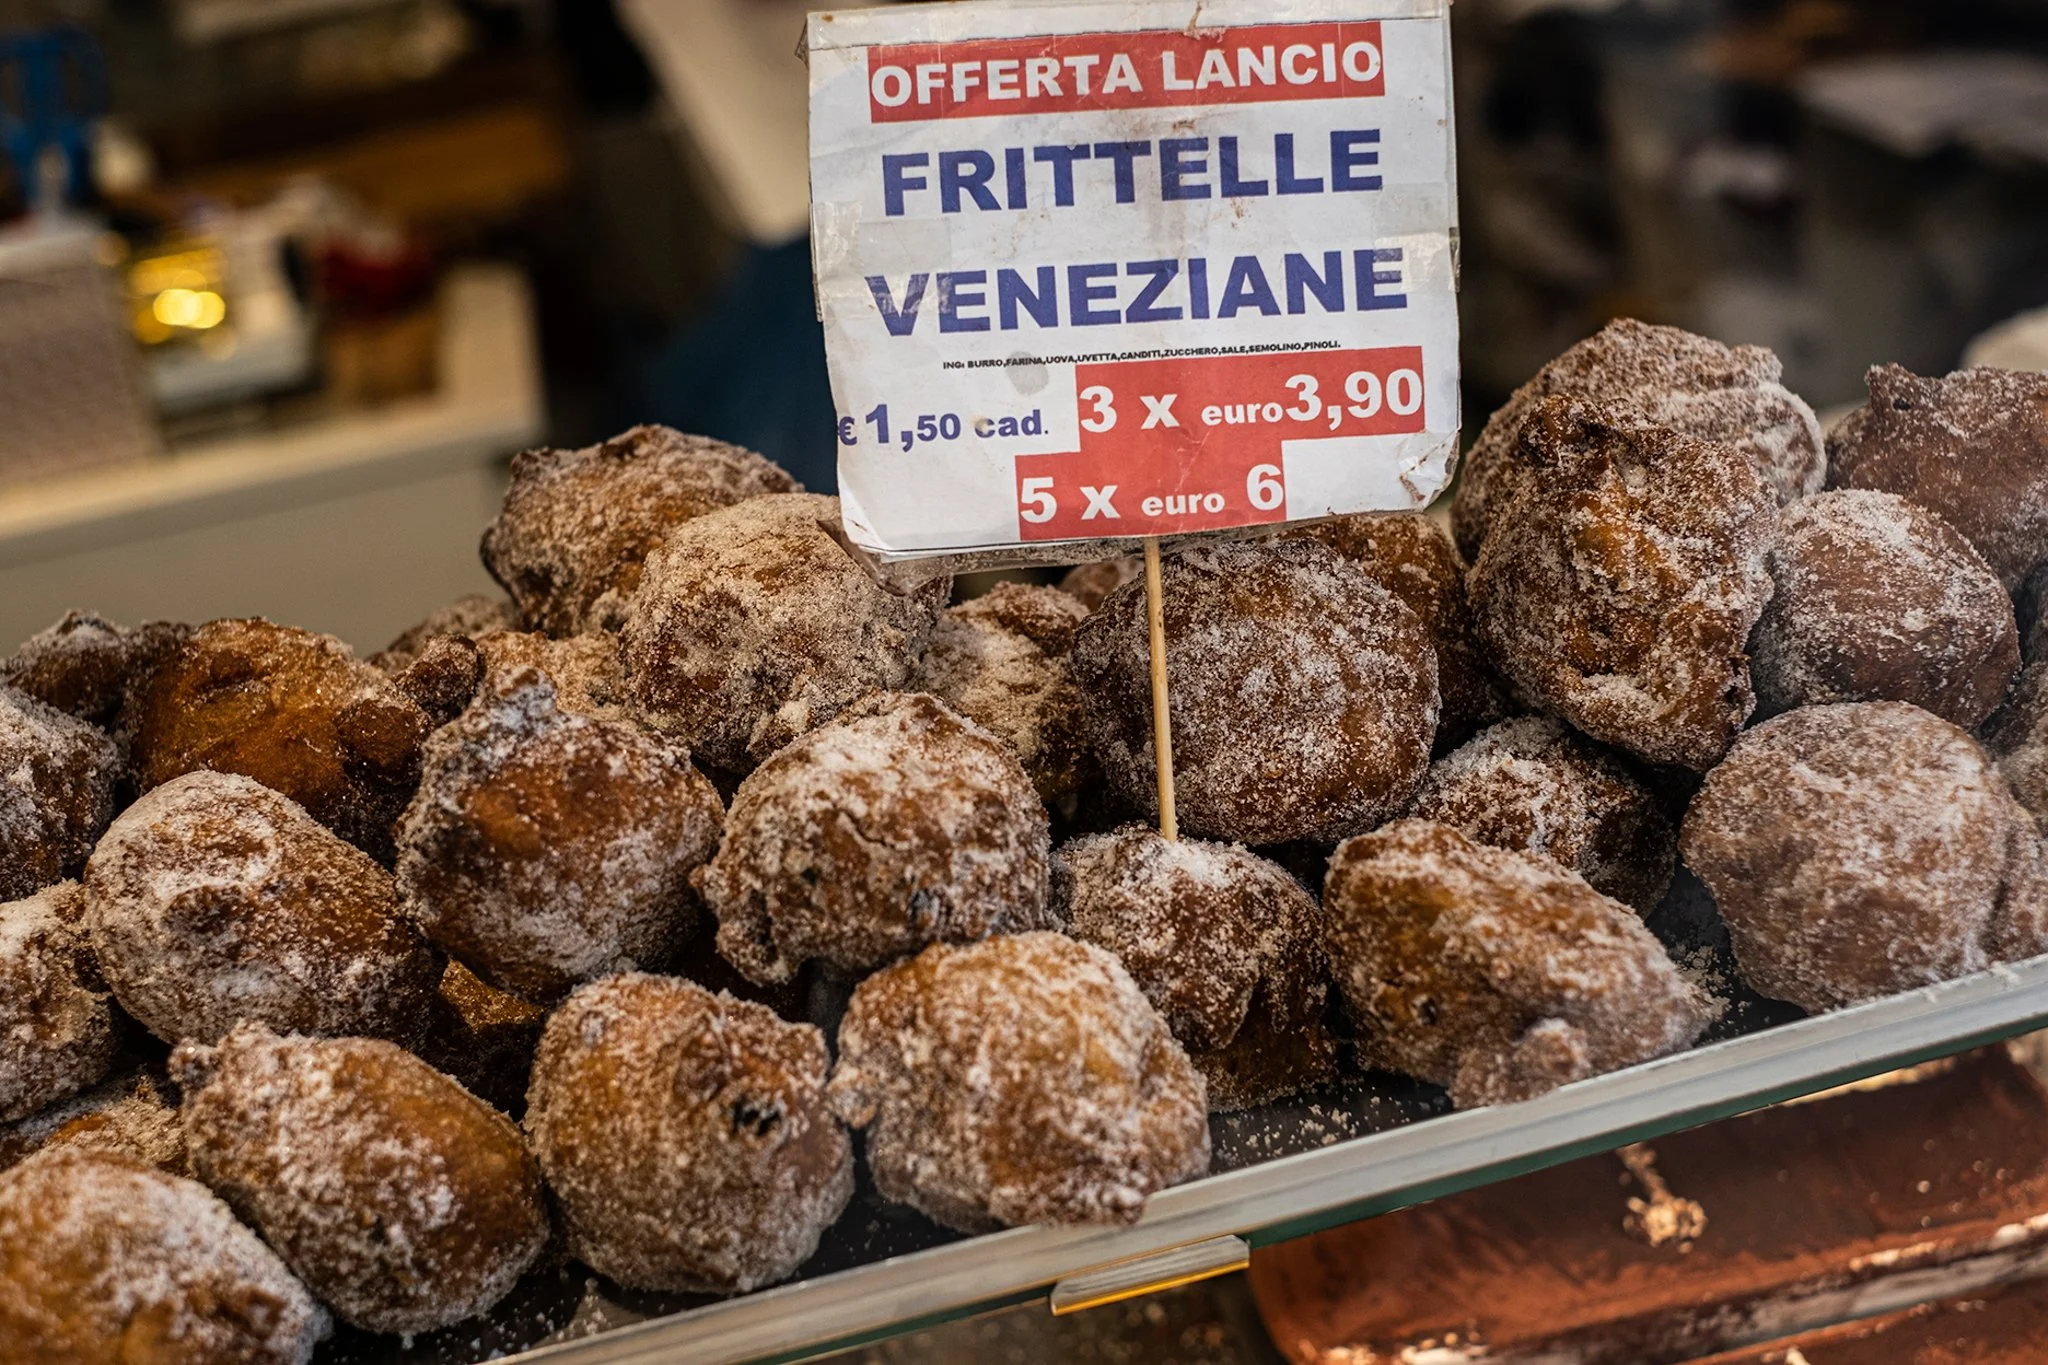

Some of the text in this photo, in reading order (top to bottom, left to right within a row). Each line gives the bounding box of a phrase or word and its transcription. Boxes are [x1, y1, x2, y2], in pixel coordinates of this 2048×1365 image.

[870, 40, 1382, 107] OFFERTA LANCIO
[882, 128, 1384, 217] FRITTELLE
[864, 246, 1408, 337] VENEZIANE
[973, 408, 1049, 439] cad.
[1079, 385, 1118, 433] 3
[1020, 476, 1058, 524] 5
[1141, 492, 1225, 517] euro
[1246, 463, 1284, 511] 6
